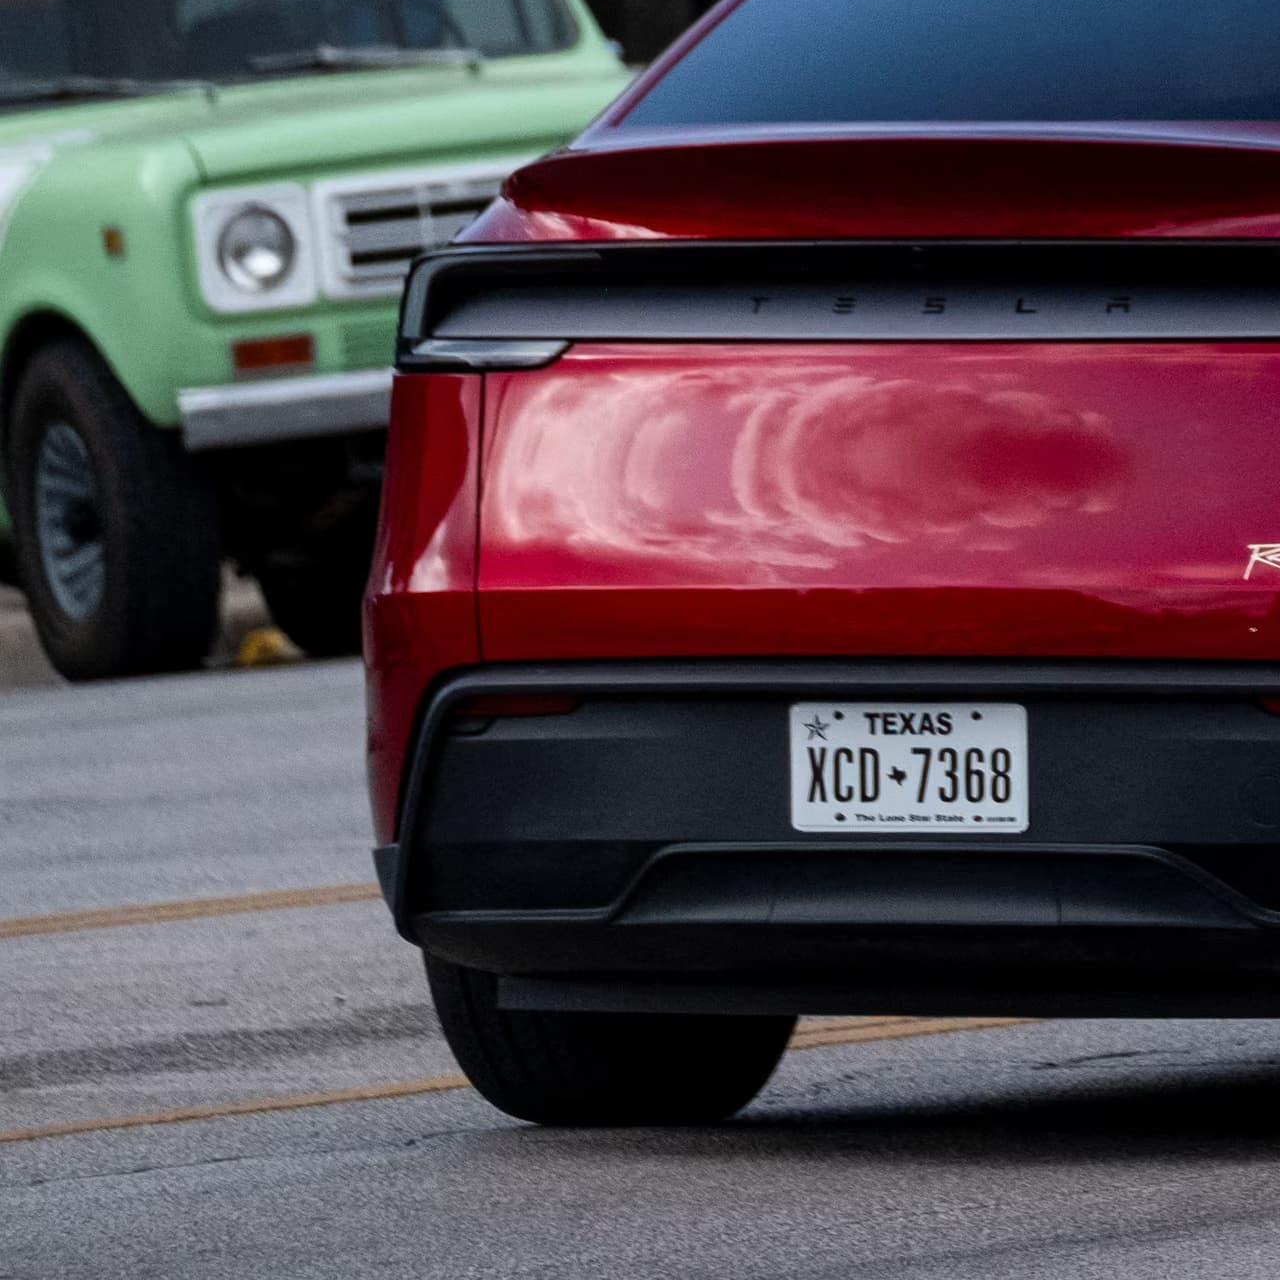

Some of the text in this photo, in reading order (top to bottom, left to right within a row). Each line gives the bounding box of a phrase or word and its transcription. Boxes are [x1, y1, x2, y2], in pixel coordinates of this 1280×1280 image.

[750, 296, 1131, 315] TESLA
[863, 712, 953, 736] TEXAS
[855, 813, 964, 823] The Lone Star State
